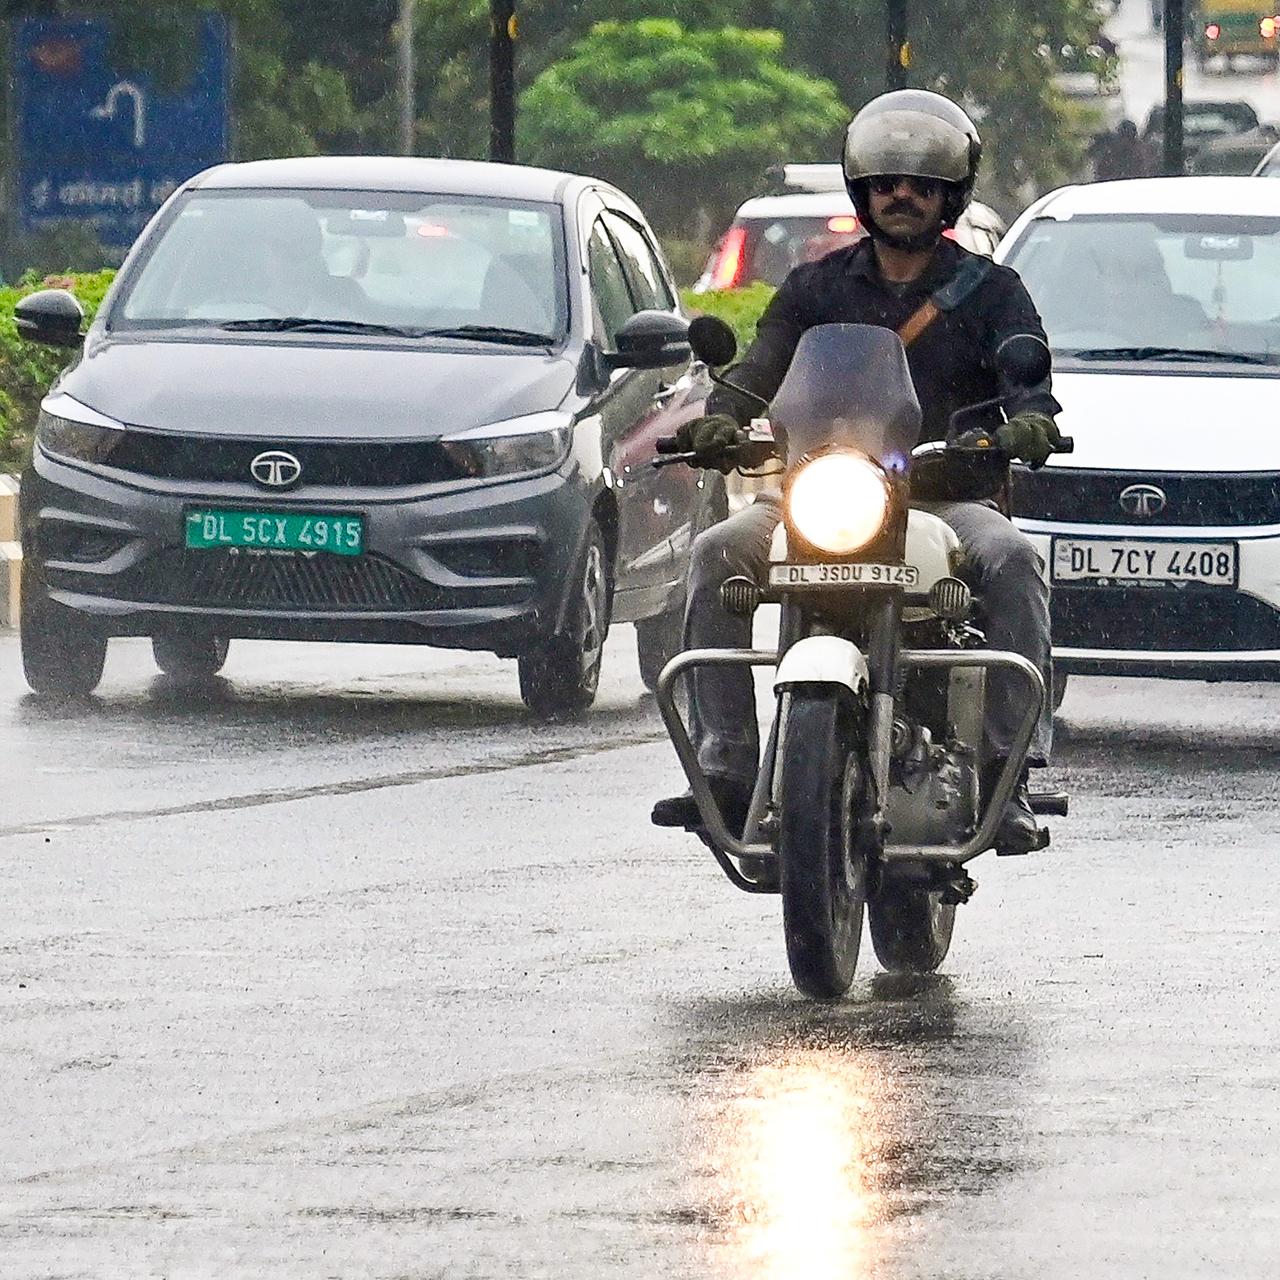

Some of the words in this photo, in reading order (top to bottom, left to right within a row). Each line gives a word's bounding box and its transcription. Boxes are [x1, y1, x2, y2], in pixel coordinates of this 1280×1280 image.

[203, 515, 232, 542] DL
[242, 517, 287, 544] 5CX
[299, 520, 361, 547] 4915
[789, 568, 809, 582] DL
[872, 566, 915, 583] 9145
[1071, 548, 1100, 573] DL
[1111, 549, 1156, 575] 7CY
[1167, 551, 1229, 577] 4408
